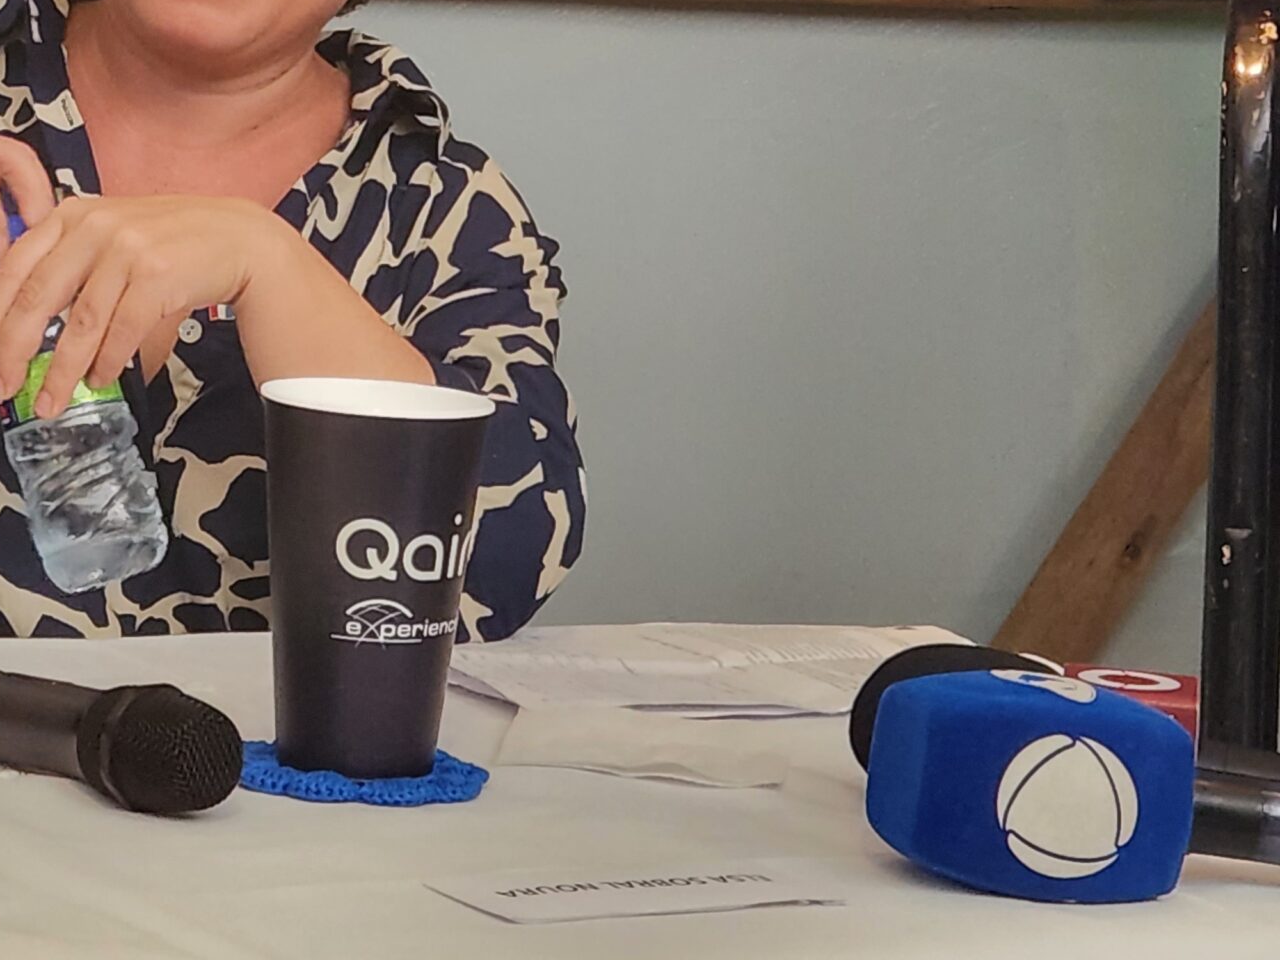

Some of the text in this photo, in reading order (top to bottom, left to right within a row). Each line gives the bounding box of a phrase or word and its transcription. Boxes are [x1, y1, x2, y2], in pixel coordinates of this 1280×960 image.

[336, 513, 472, 581] Qair
[495, 881, 598, 898] NOURA
[601, 876, 709, 890] SOBRAL
